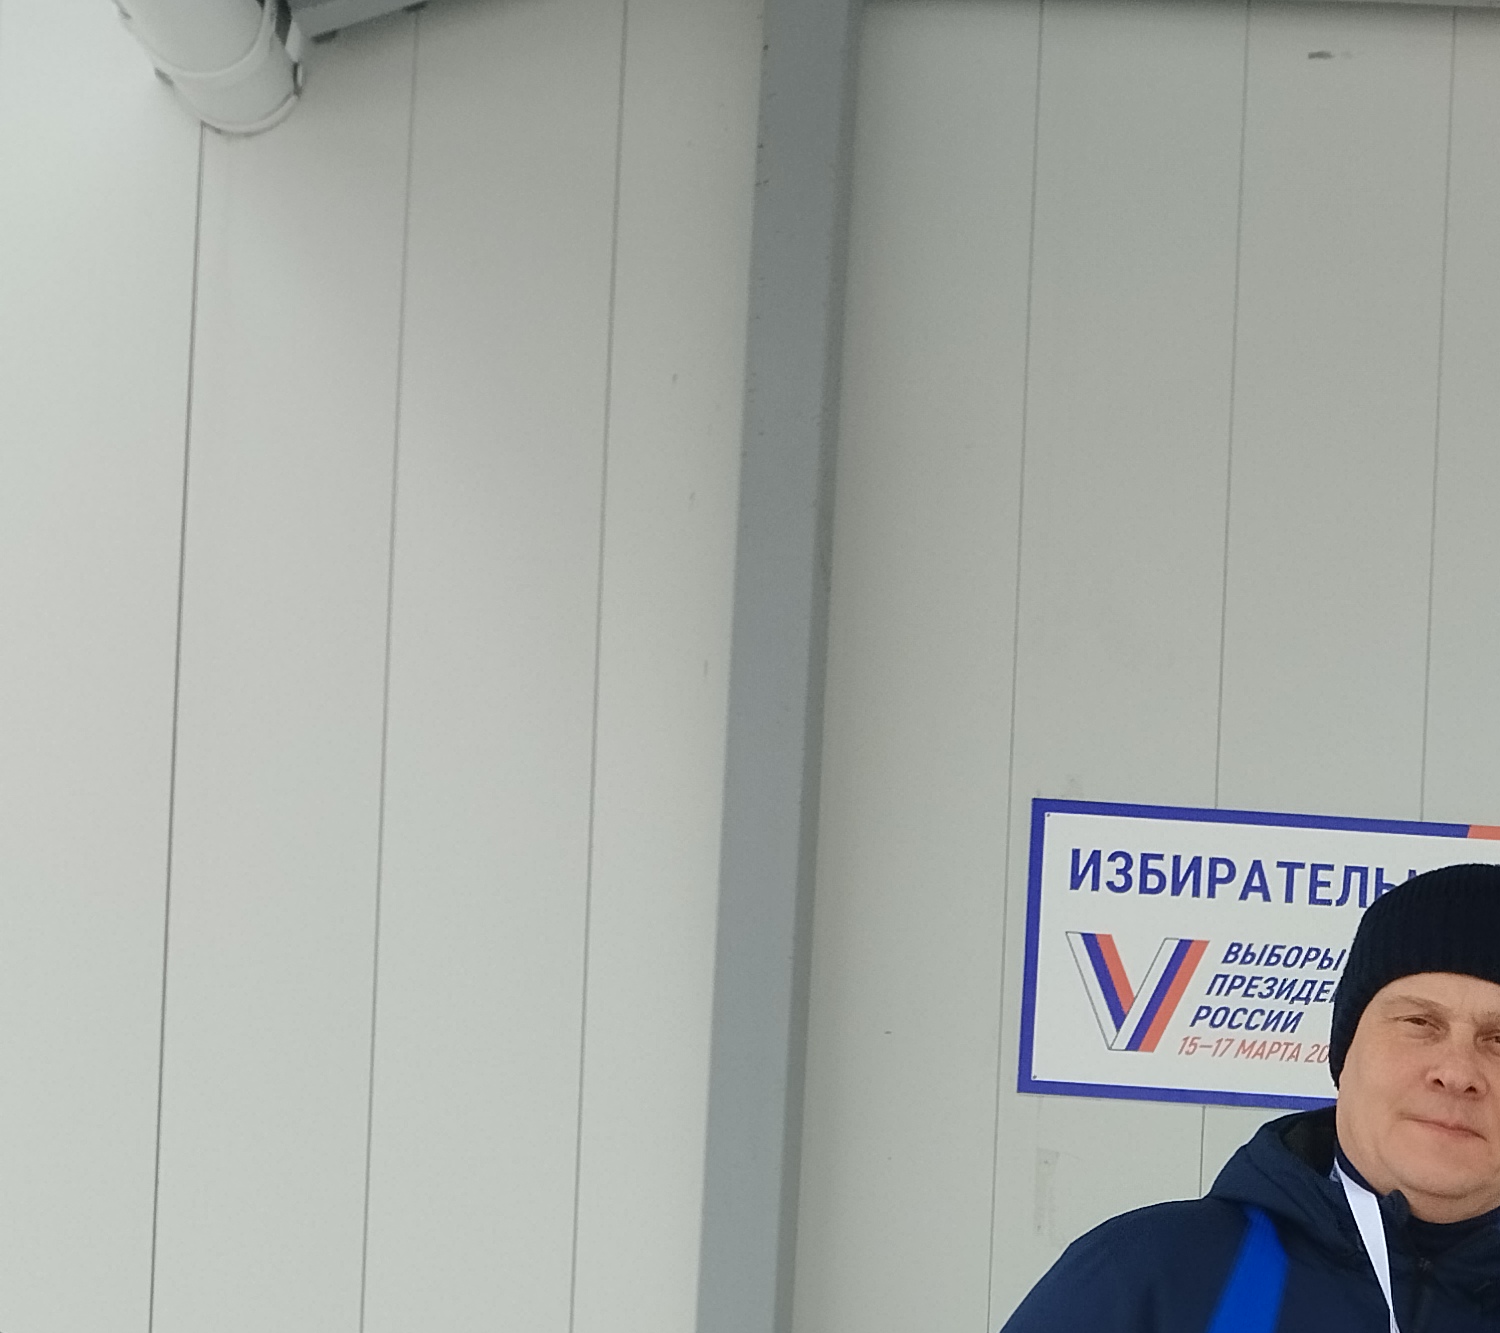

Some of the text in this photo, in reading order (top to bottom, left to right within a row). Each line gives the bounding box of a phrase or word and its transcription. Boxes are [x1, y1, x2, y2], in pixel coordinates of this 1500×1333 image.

[1069, 848, 1419, 909] ИЗБИРАТЕЛЬ
[1221, 941, 1348, 972] ВЫБОРЫ
[1205, 973, 1337, 1006] ПРЕЗИДЕ
[1189, 1005, 1305, 1034] РОССИИ
[1234, 1039, 1303, 1063] МАРТА
